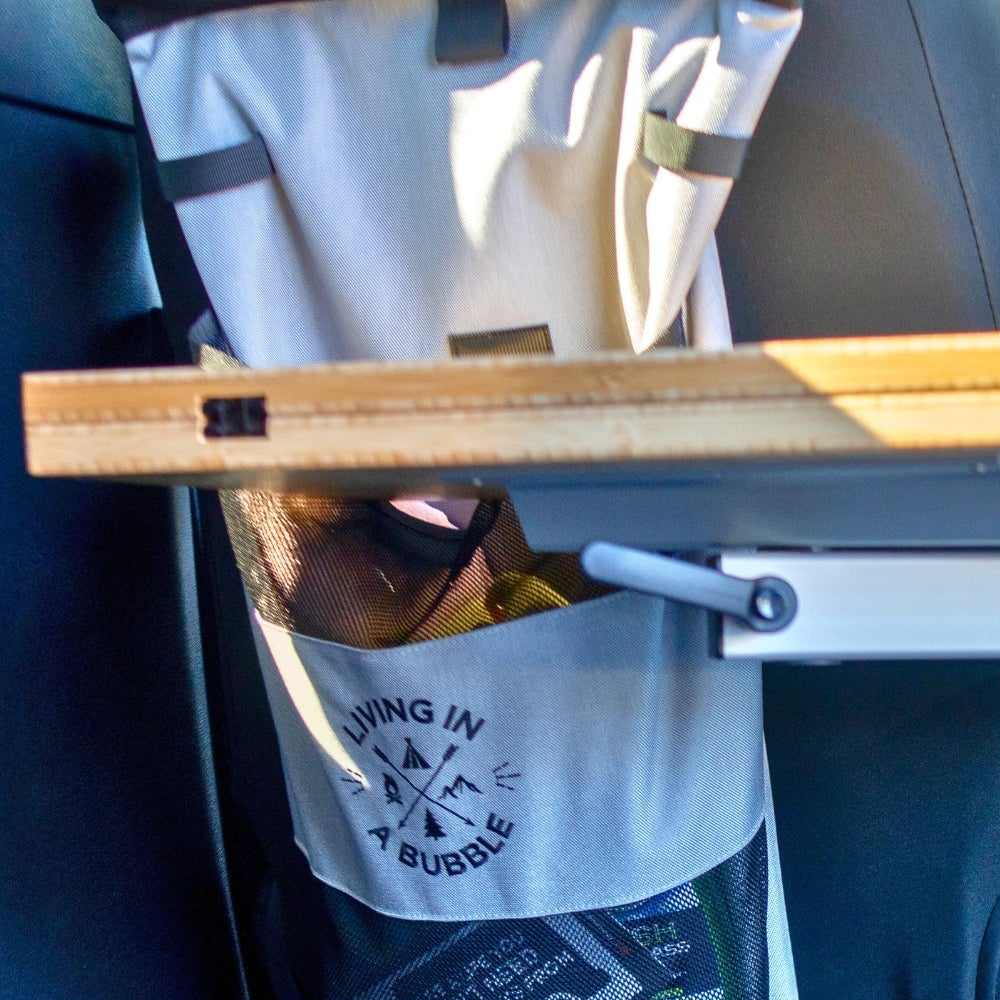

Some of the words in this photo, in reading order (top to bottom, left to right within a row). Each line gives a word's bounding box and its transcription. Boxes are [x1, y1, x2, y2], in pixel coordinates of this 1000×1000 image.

[342, 698, 434, 746] LIVING
[443, 705, 486, 741] IN
[367, 826, 391, 851] A
[398, 812, 514, 876] BUBBLE
[481, 947, 540, 993] NEED
[522, 949, 576, 992] FROM
